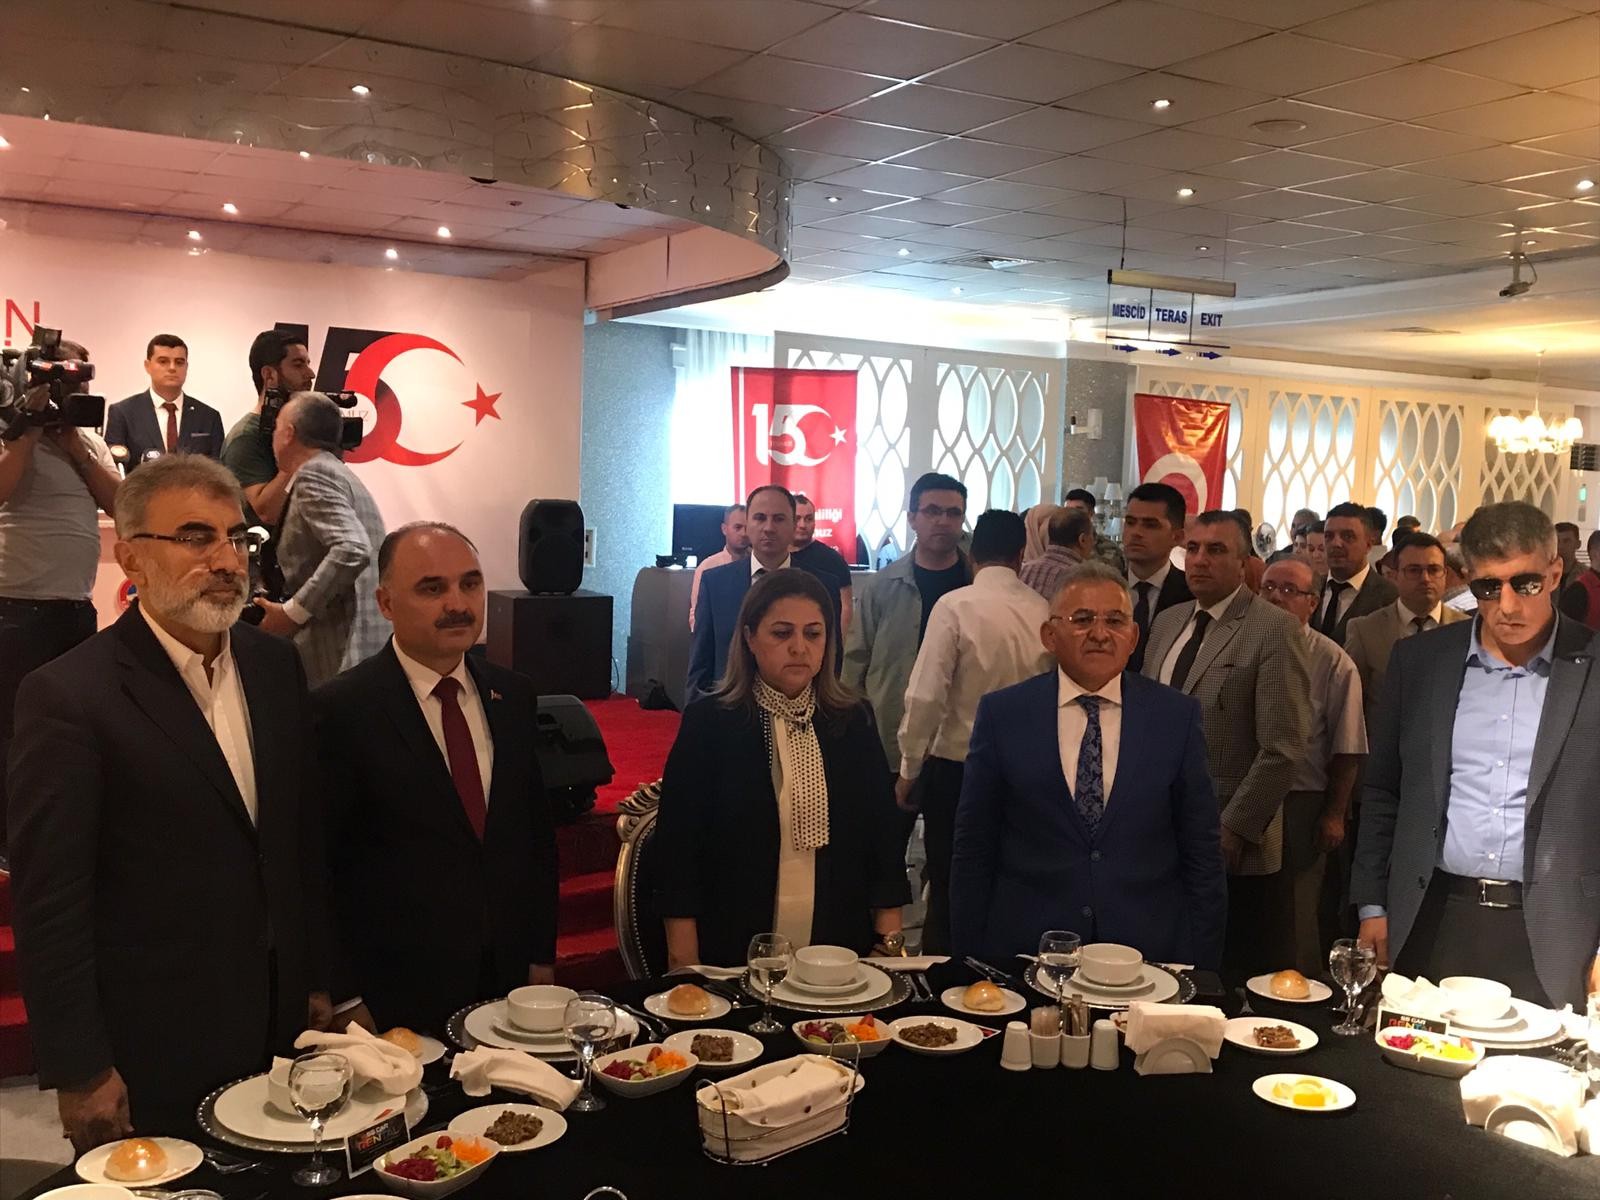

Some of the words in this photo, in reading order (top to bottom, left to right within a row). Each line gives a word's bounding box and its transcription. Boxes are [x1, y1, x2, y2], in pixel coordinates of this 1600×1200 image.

[1112, 303, 1146, 320] MESCİD
[1155, 308, 1188, 324] TERAS
[1200, 312, 1223, 327] EXIT
[752, 403, 807, 466] 15
